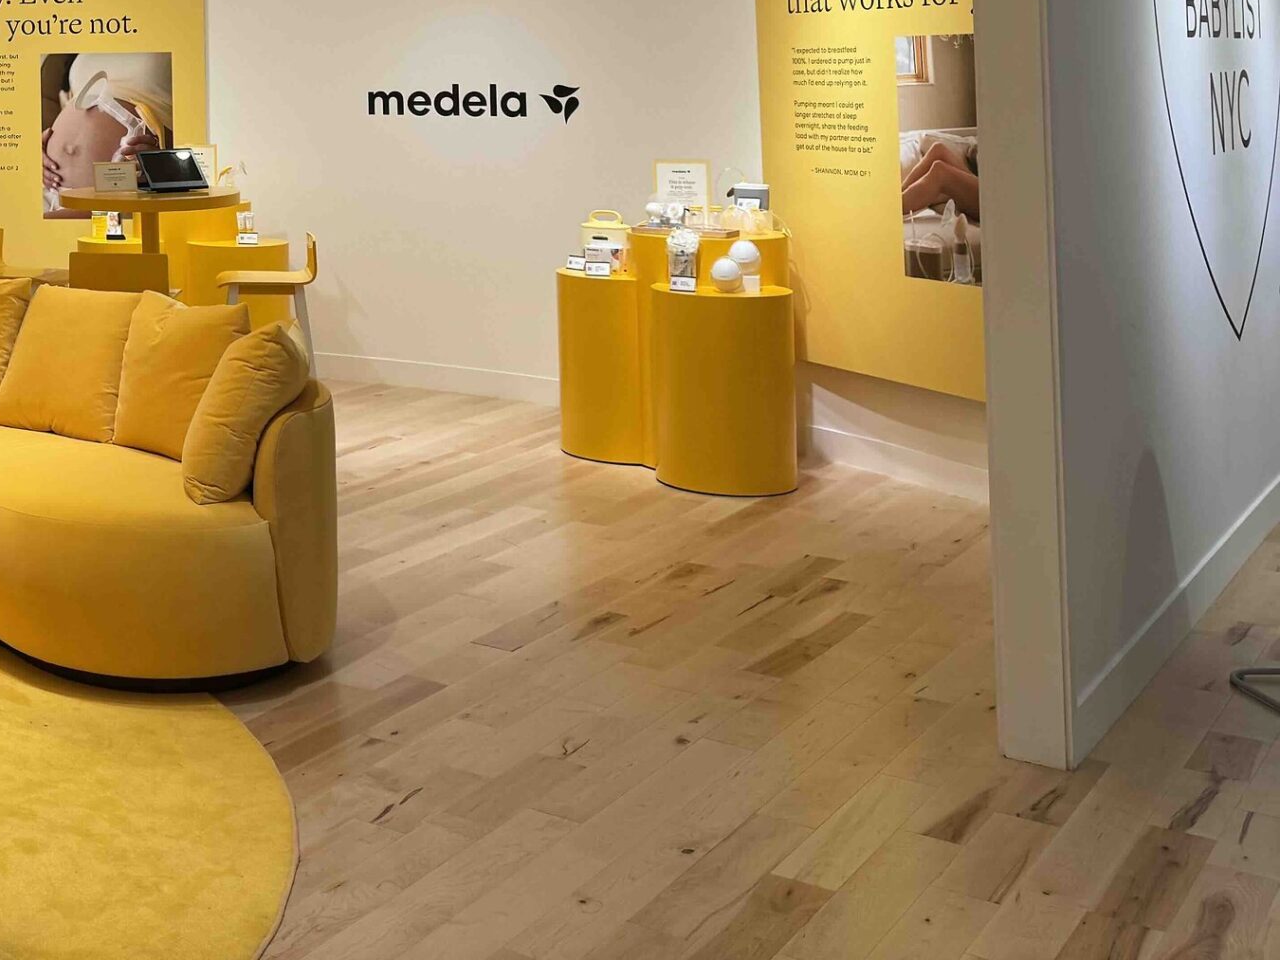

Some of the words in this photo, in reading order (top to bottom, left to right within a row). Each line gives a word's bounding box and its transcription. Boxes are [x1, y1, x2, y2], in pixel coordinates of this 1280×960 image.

[7, 14, 83, 42] you’re
[89, 15, 138, 34] not.
[368, 84, 527, 117] medela
[1209, 70, 1252, 156] NYC
